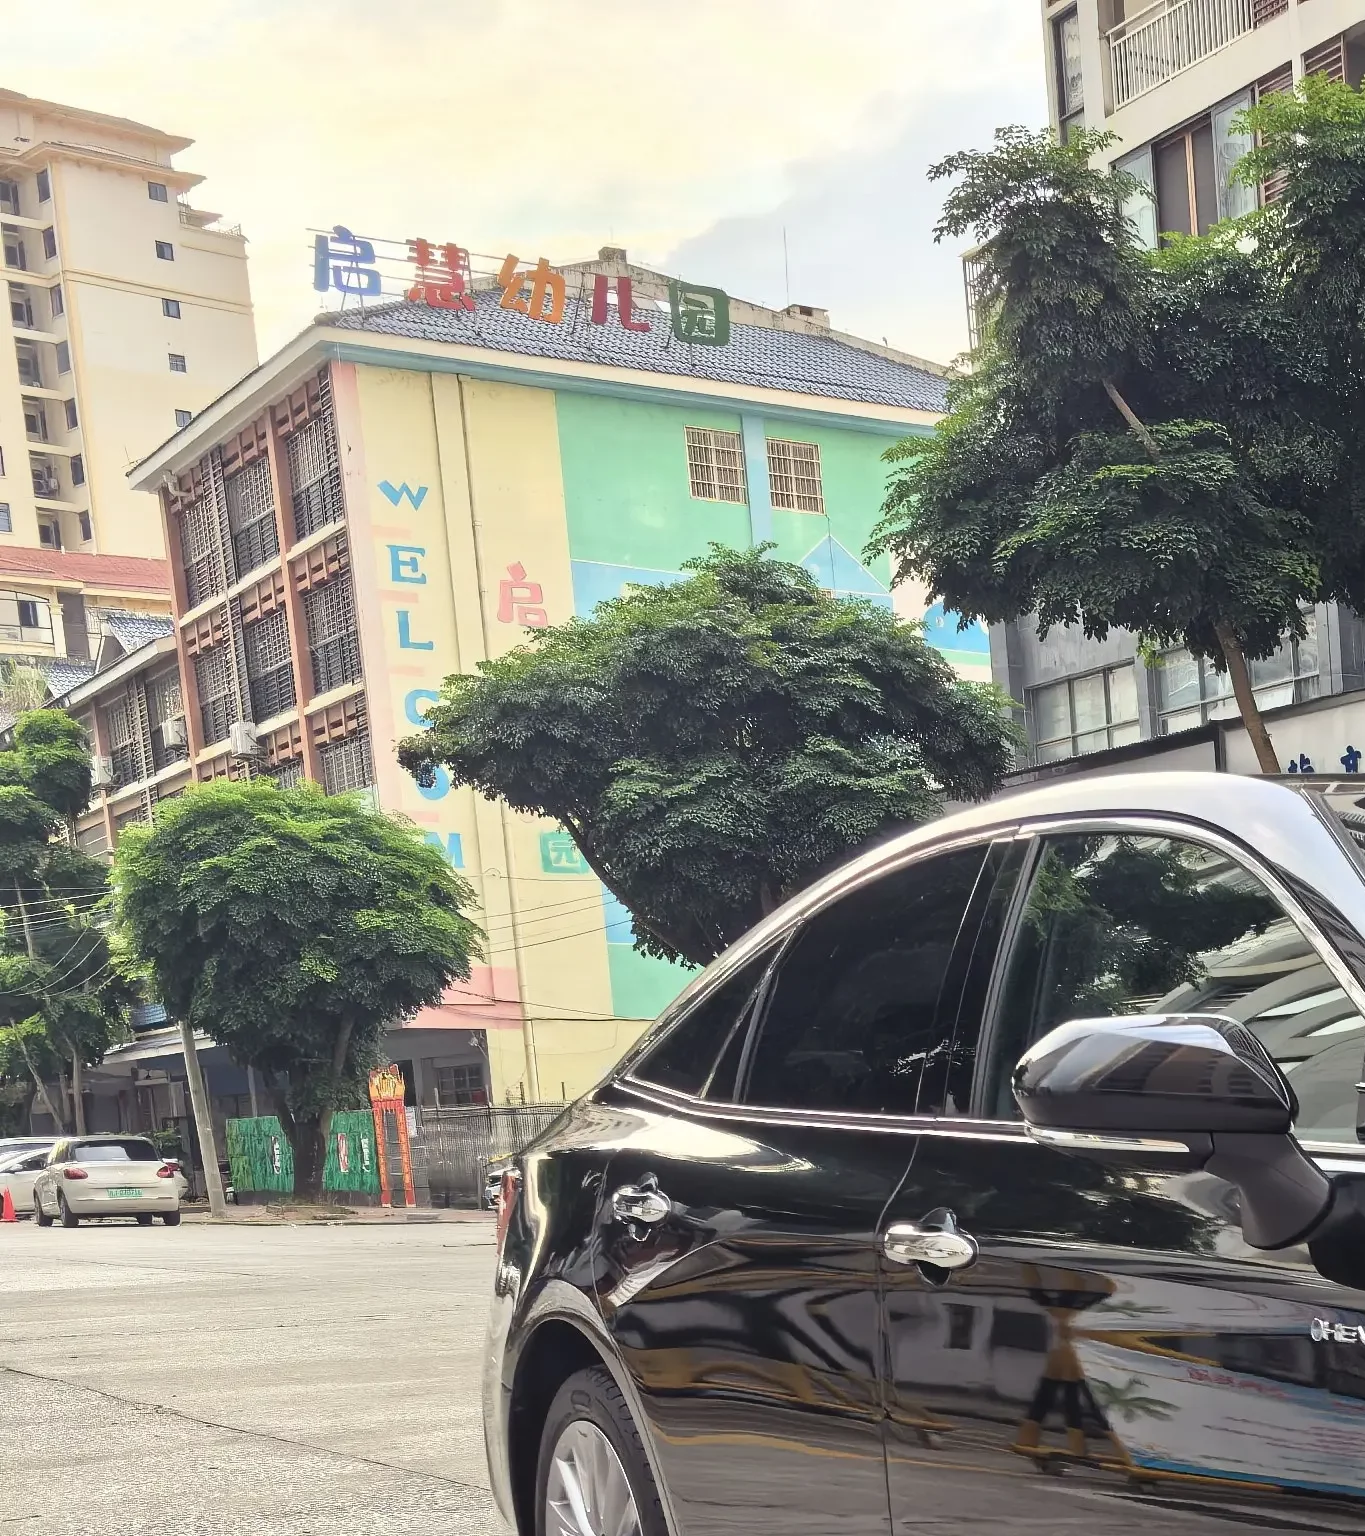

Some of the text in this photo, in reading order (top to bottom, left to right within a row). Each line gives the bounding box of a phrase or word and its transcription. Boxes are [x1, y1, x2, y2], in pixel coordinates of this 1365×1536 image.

[313, 224, 731, 347] 启慧幼儿园
